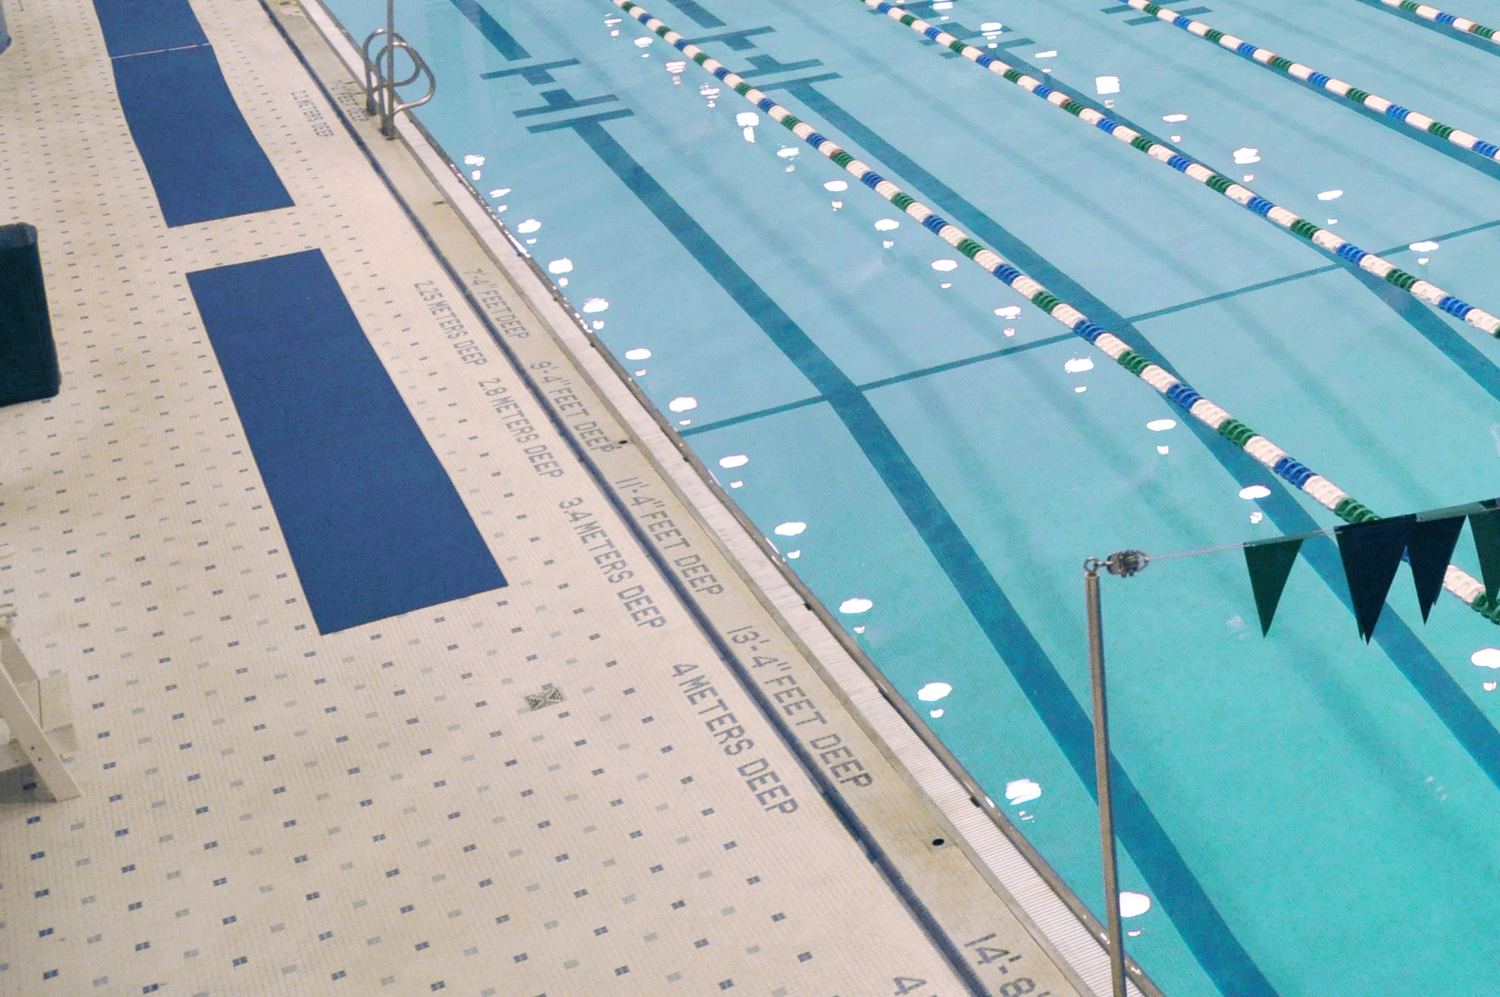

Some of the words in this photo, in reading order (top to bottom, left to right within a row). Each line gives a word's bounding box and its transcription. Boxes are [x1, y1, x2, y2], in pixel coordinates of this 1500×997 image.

[312, 122, 334, 137] DEEP
[426, 300, 468, 339] METERS
[453, 339, 488, 365] DEEP
[478, 377, 507, 397] 2.8
[490, 395, 540, 444] METERS
[549, 383, 590, 418] FEET
[574, 421, 615, 453] DEEP
[523, 439, 565, 479] DEEP
[573, 519, 635, 584] METERS
[617, 584, 666, 628] DEEP
[640, 509, 691, 550] FEET
[673, 554, 725, 595] DEEP
[672, 663, 699, 678] 4
[678, 674, 755, 756] METERS
[764, 674, 827, 726] FEET
[809, 733, 873, 788] DEEP
[737, 757, 799, 814] DEEP
